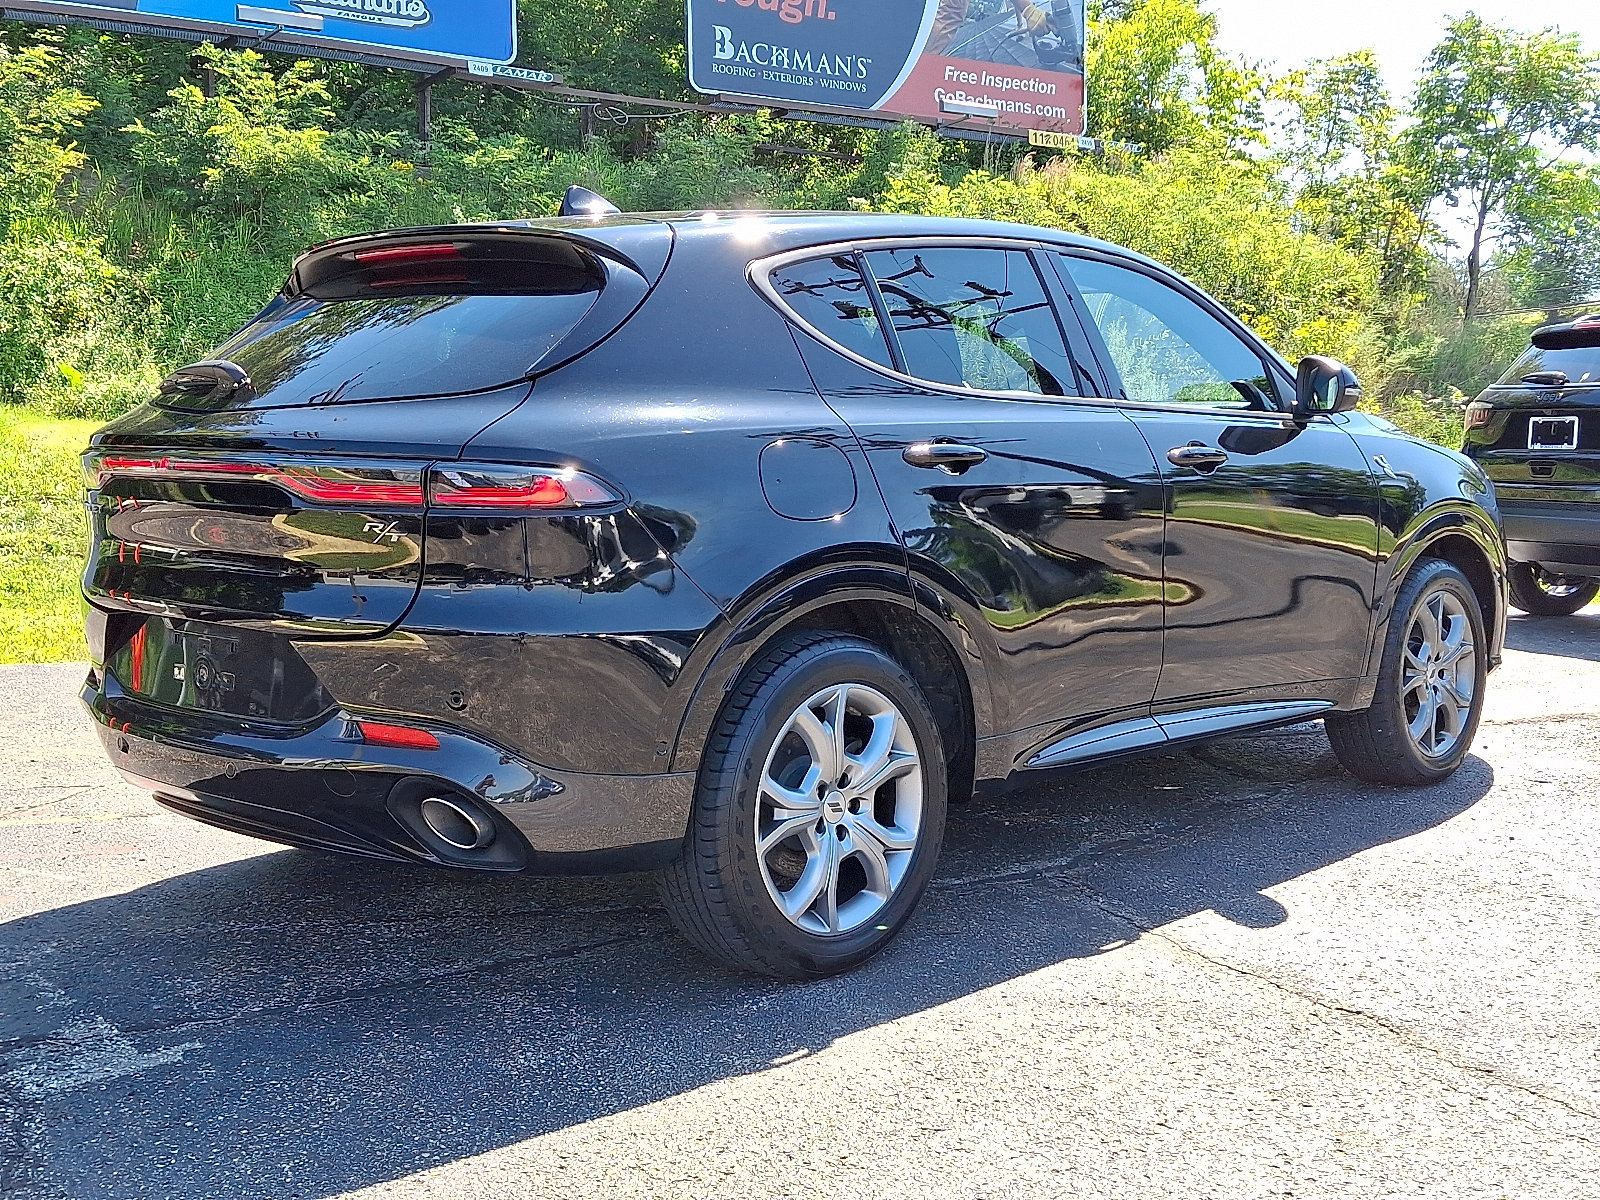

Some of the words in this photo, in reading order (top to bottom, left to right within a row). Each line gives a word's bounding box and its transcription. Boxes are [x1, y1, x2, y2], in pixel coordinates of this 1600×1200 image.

[336, 11, 383, 22] FAMOUS
[718, 0, 836, 24] ugh.
[472, 63, 489, 73] 2409
[494, 65, 549, 81] LAMAR
[712, 63, 756, 78] ROOFING
[762, 70, 814, 87] EXTERIORS
[819, 78, 867, 93] WINDOWS
[944, 65, 978, 85] Free
[980, 71, 1056, 95] Inspection
[1535, 391, 1563, 403] Jeep
[363, 520, 408, 544] R/T
